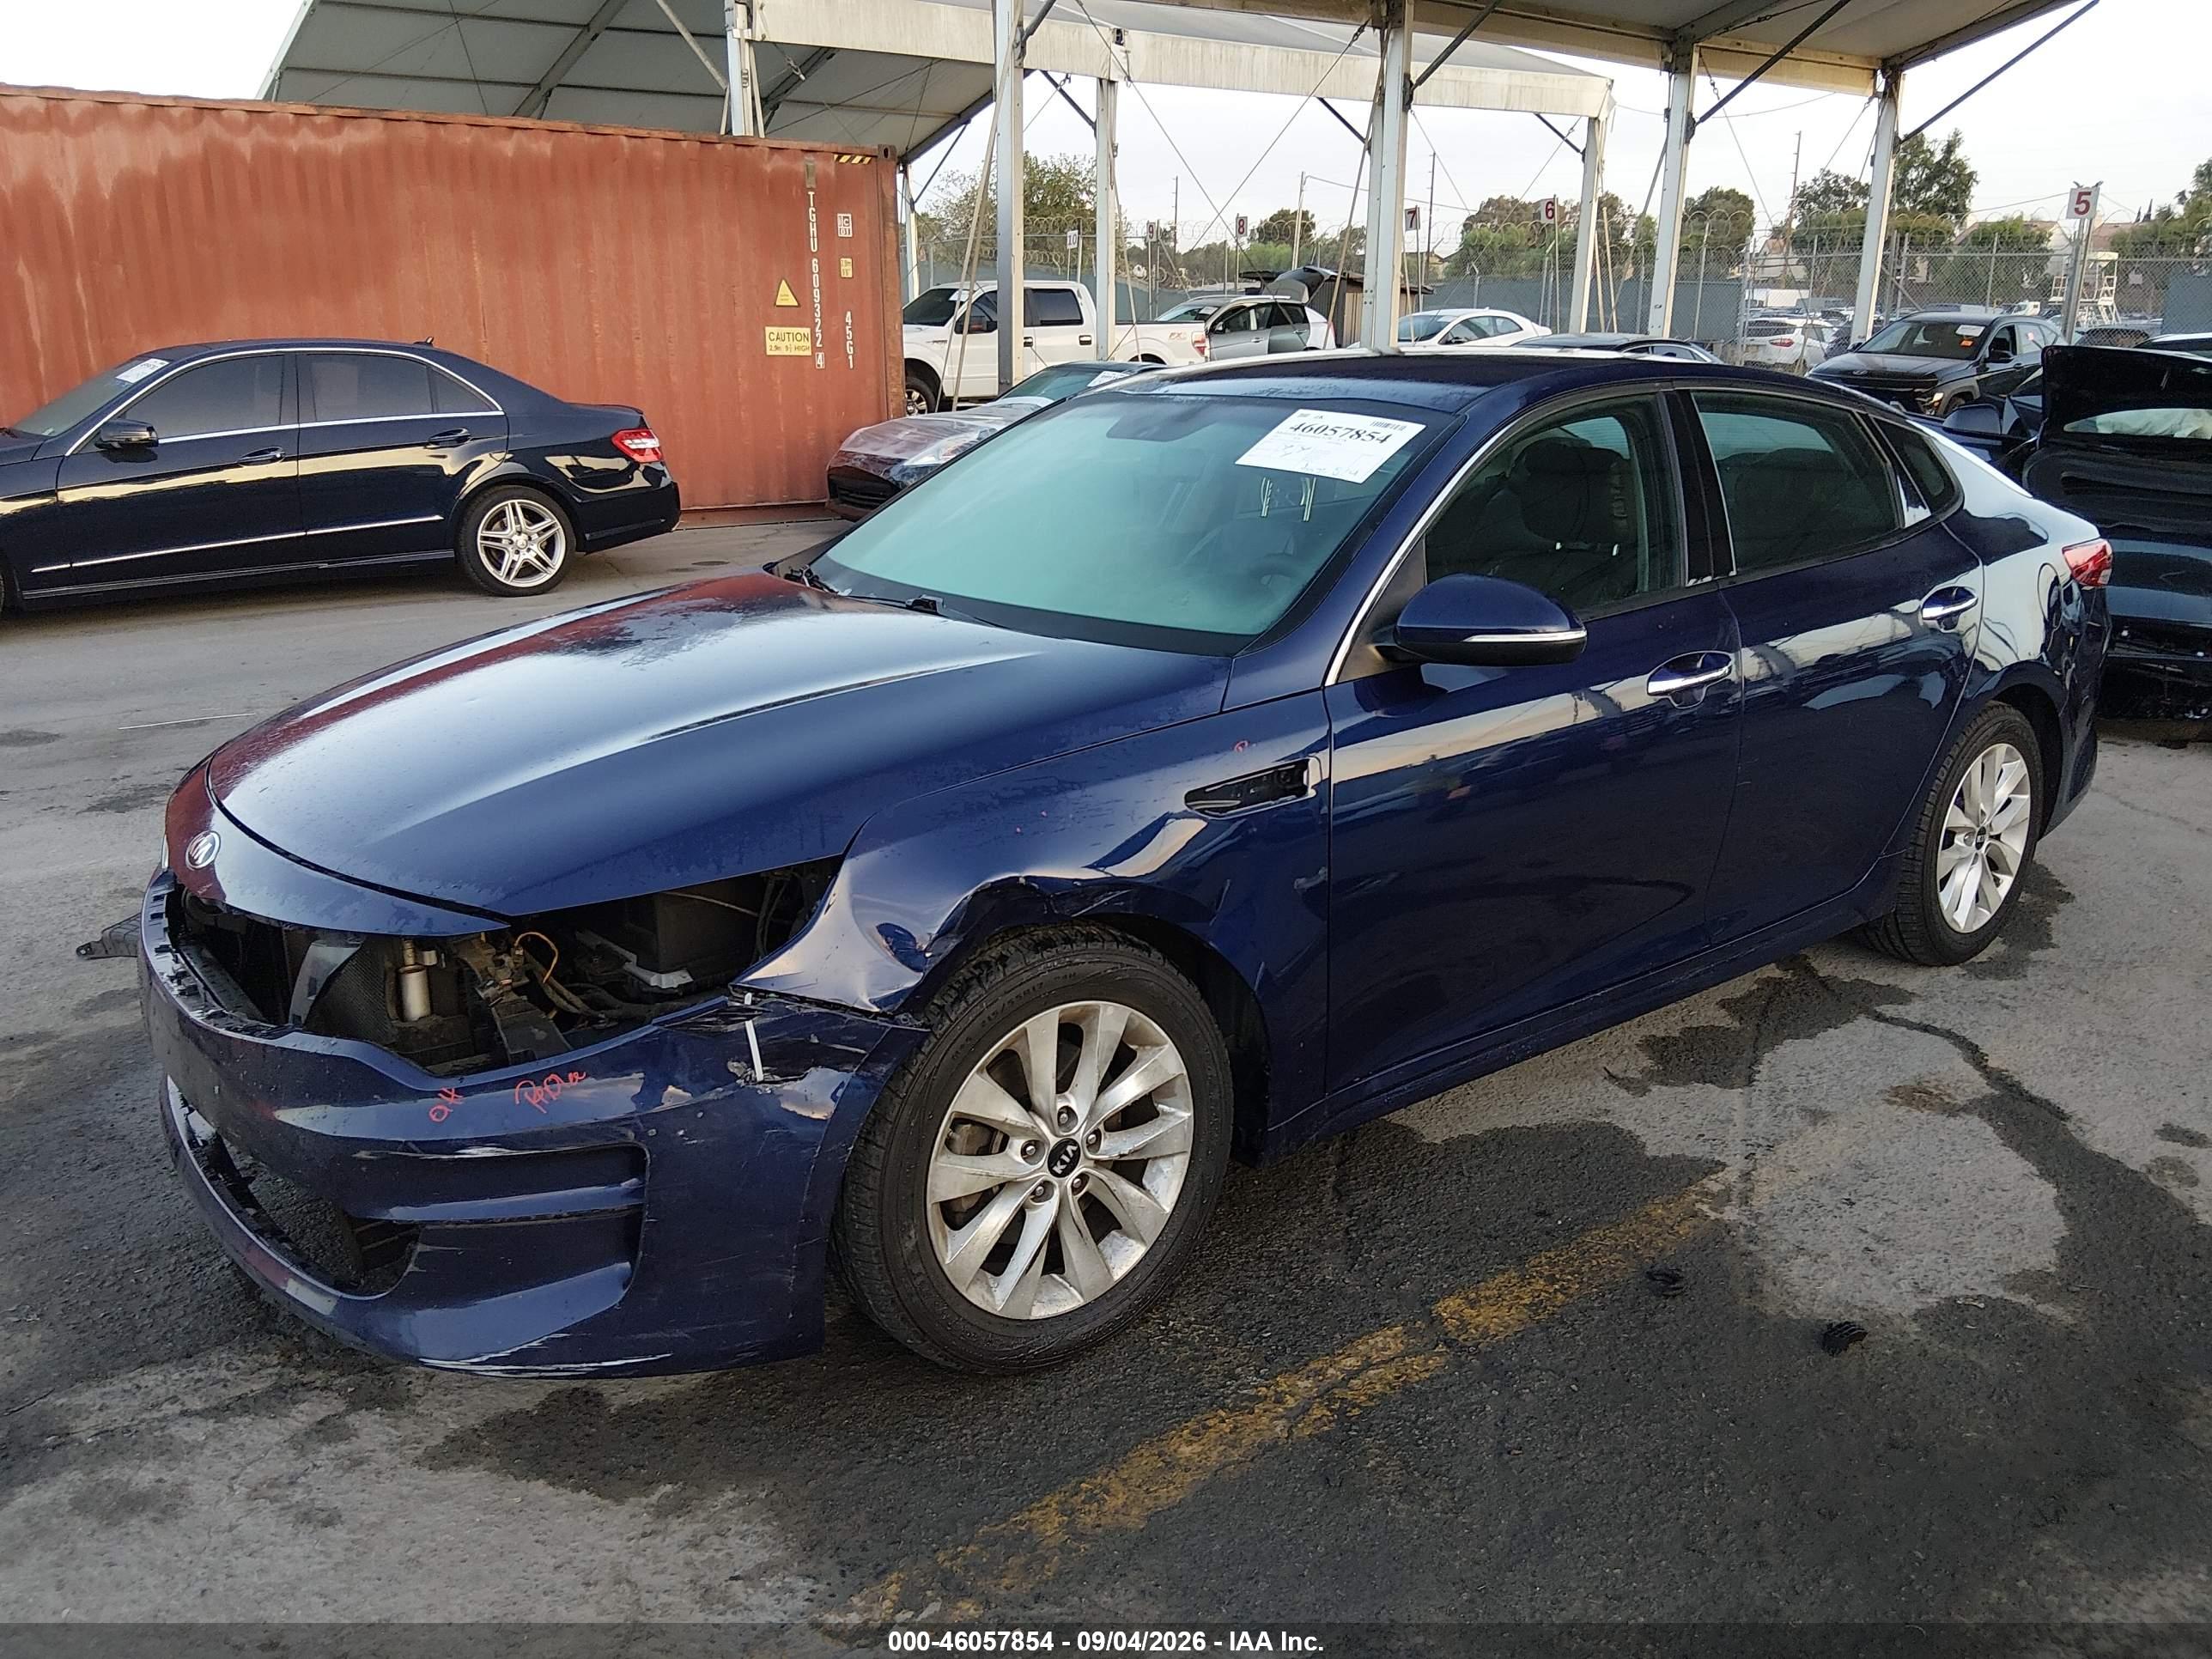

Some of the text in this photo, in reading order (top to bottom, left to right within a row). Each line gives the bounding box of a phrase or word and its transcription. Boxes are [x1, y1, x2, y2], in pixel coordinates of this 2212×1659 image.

[1545, 201, 1554, 220] 6
[2074, 191, 2093, 216] 5
[1237, 218, 1245, 235] 8
[1407, 210, 1417, 228] 7
[1068, 234, 1078, 246] 10
[1148, 224, 1155, 240] 9
[807, 191, 825, 368] TGHU 609322 4
[769, 331, 810, 343] CAUTION
[845, 311, 854, 369] 45G1
[1290, 422, 1393, 444] 46057854
[1052, 1145, 1079, 1174] KIA
